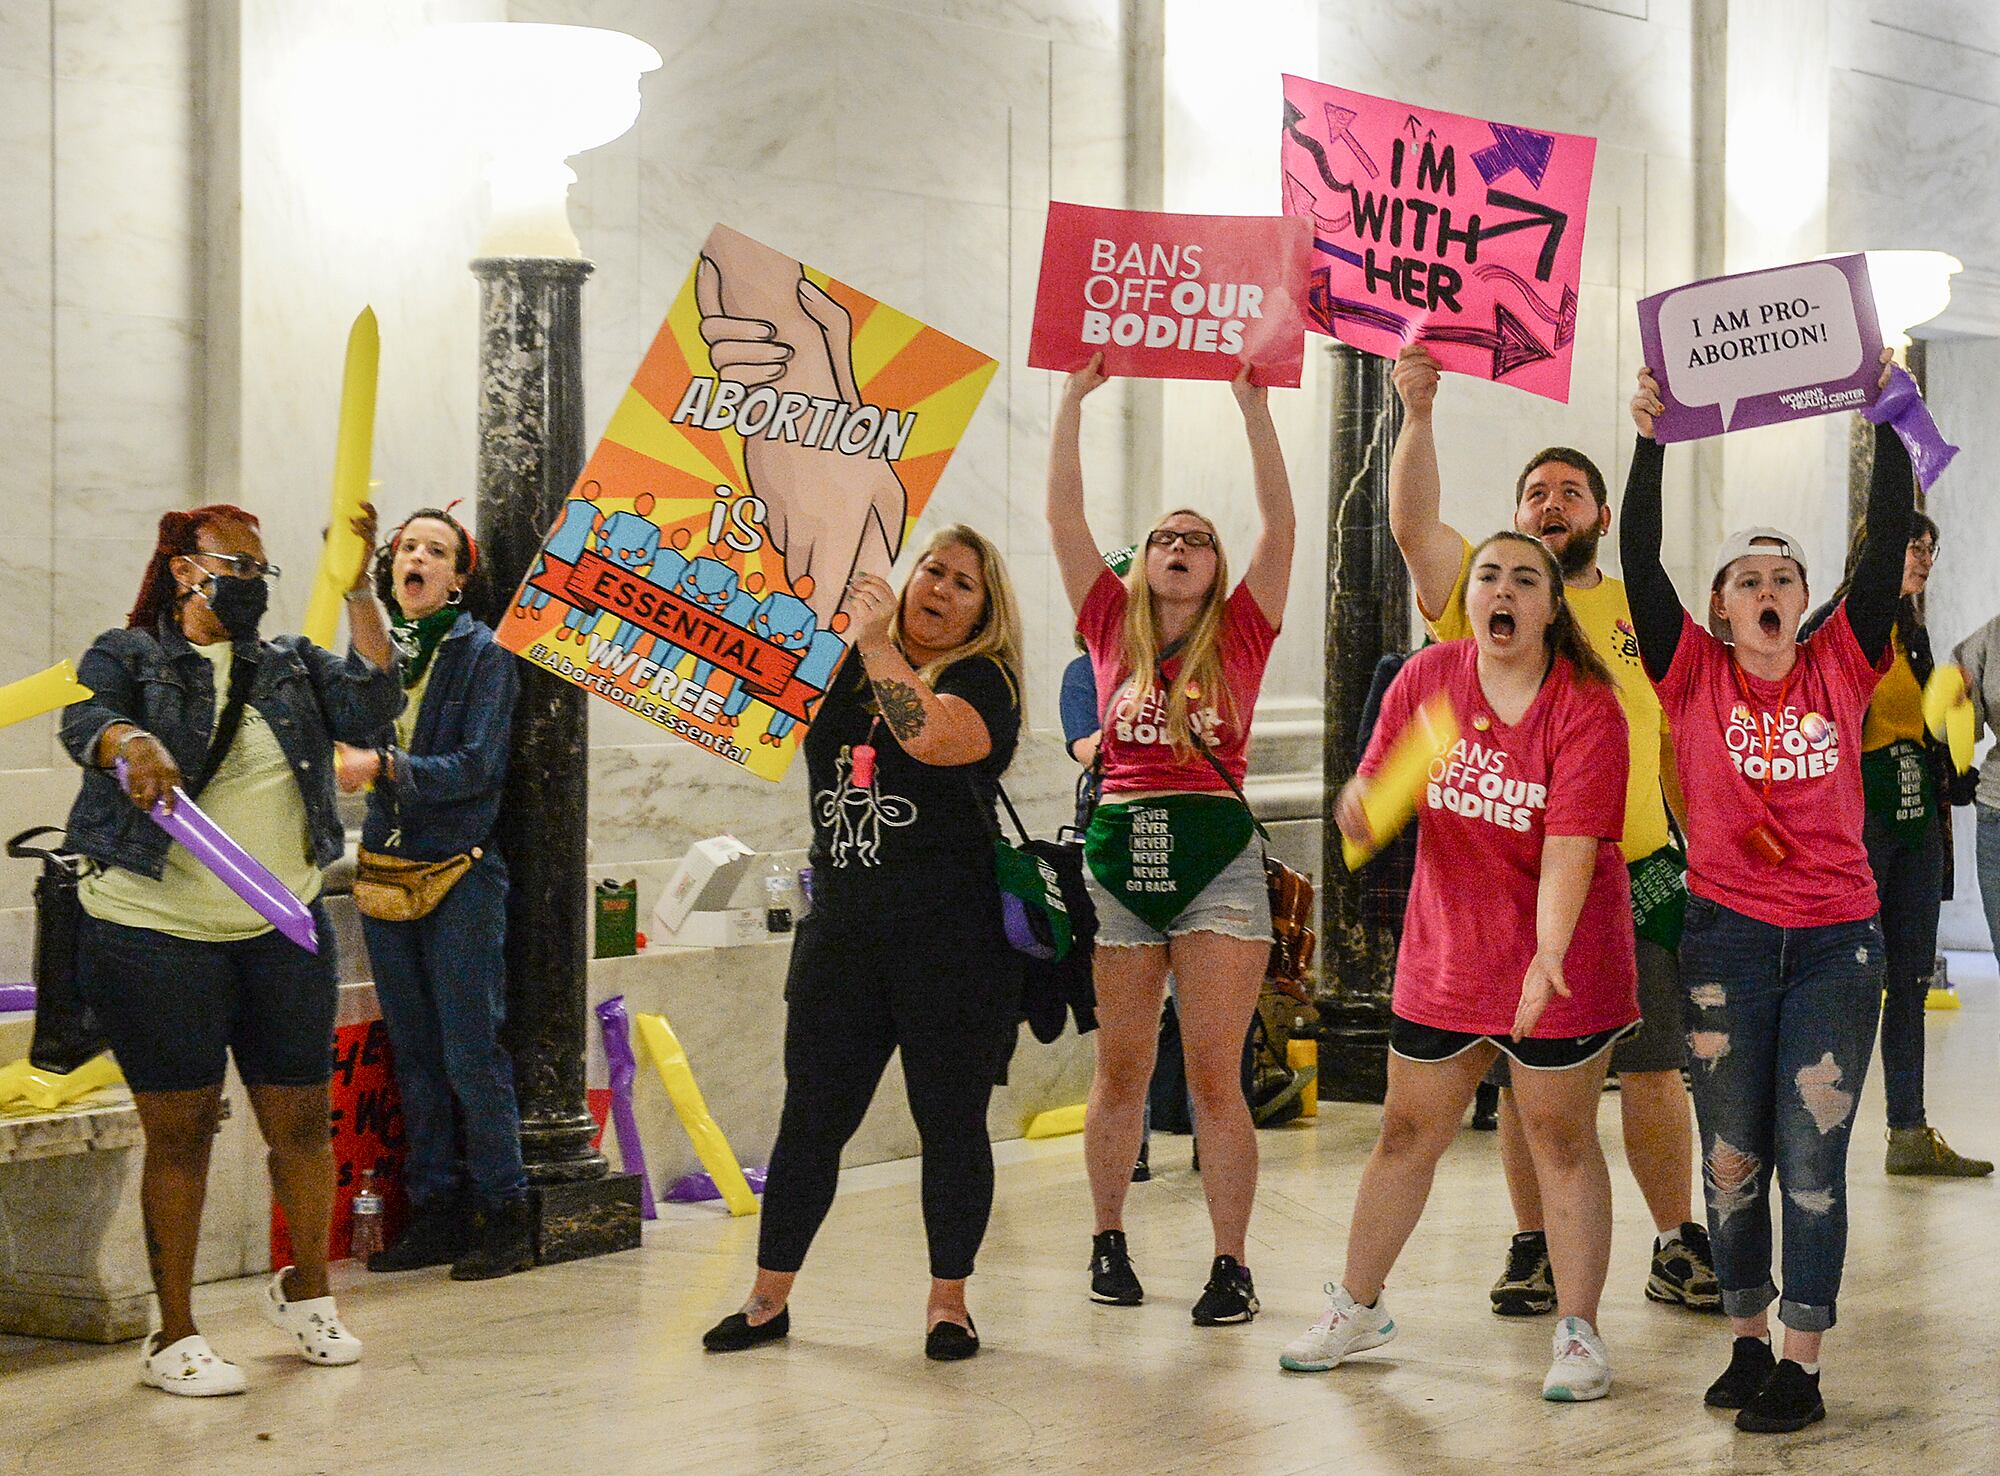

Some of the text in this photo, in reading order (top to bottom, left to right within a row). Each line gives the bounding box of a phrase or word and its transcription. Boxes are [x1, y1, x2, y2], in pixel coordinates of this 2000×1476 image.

[1350, 186, 1481, 264] WITH
[1091, 239, 1203, 280] BANS
[1365, 248, 1463, 313] HER
[1084, 275, 1263, 319] OFF OUR
[1692, 298, 1820, 338] I AM PRO-
[1081, 310, 1246, 355] BODIES
[1688, 323, 1828, 369] ABORTION!
[671, 376, 917, 461] ABORTION
[594, 571, 763, 675] ESSENTIAL
[529, 643, 751, 765] #AbortionIsEssential
[1428, 757, 1546, 809] OFF OUR
[1131, 809, 1169, 823] NEVER
[1131, 822, 1168, 834] NEVER
[1427, 782, 1533, 833] BODIES
[1132, 852, 1169, 864] NEVER
[1133, 836, 1168, 850] NEVER
[1126, 879, 1177, 892] GO BACK
[1132, 865, 1169, 878] NEVER
